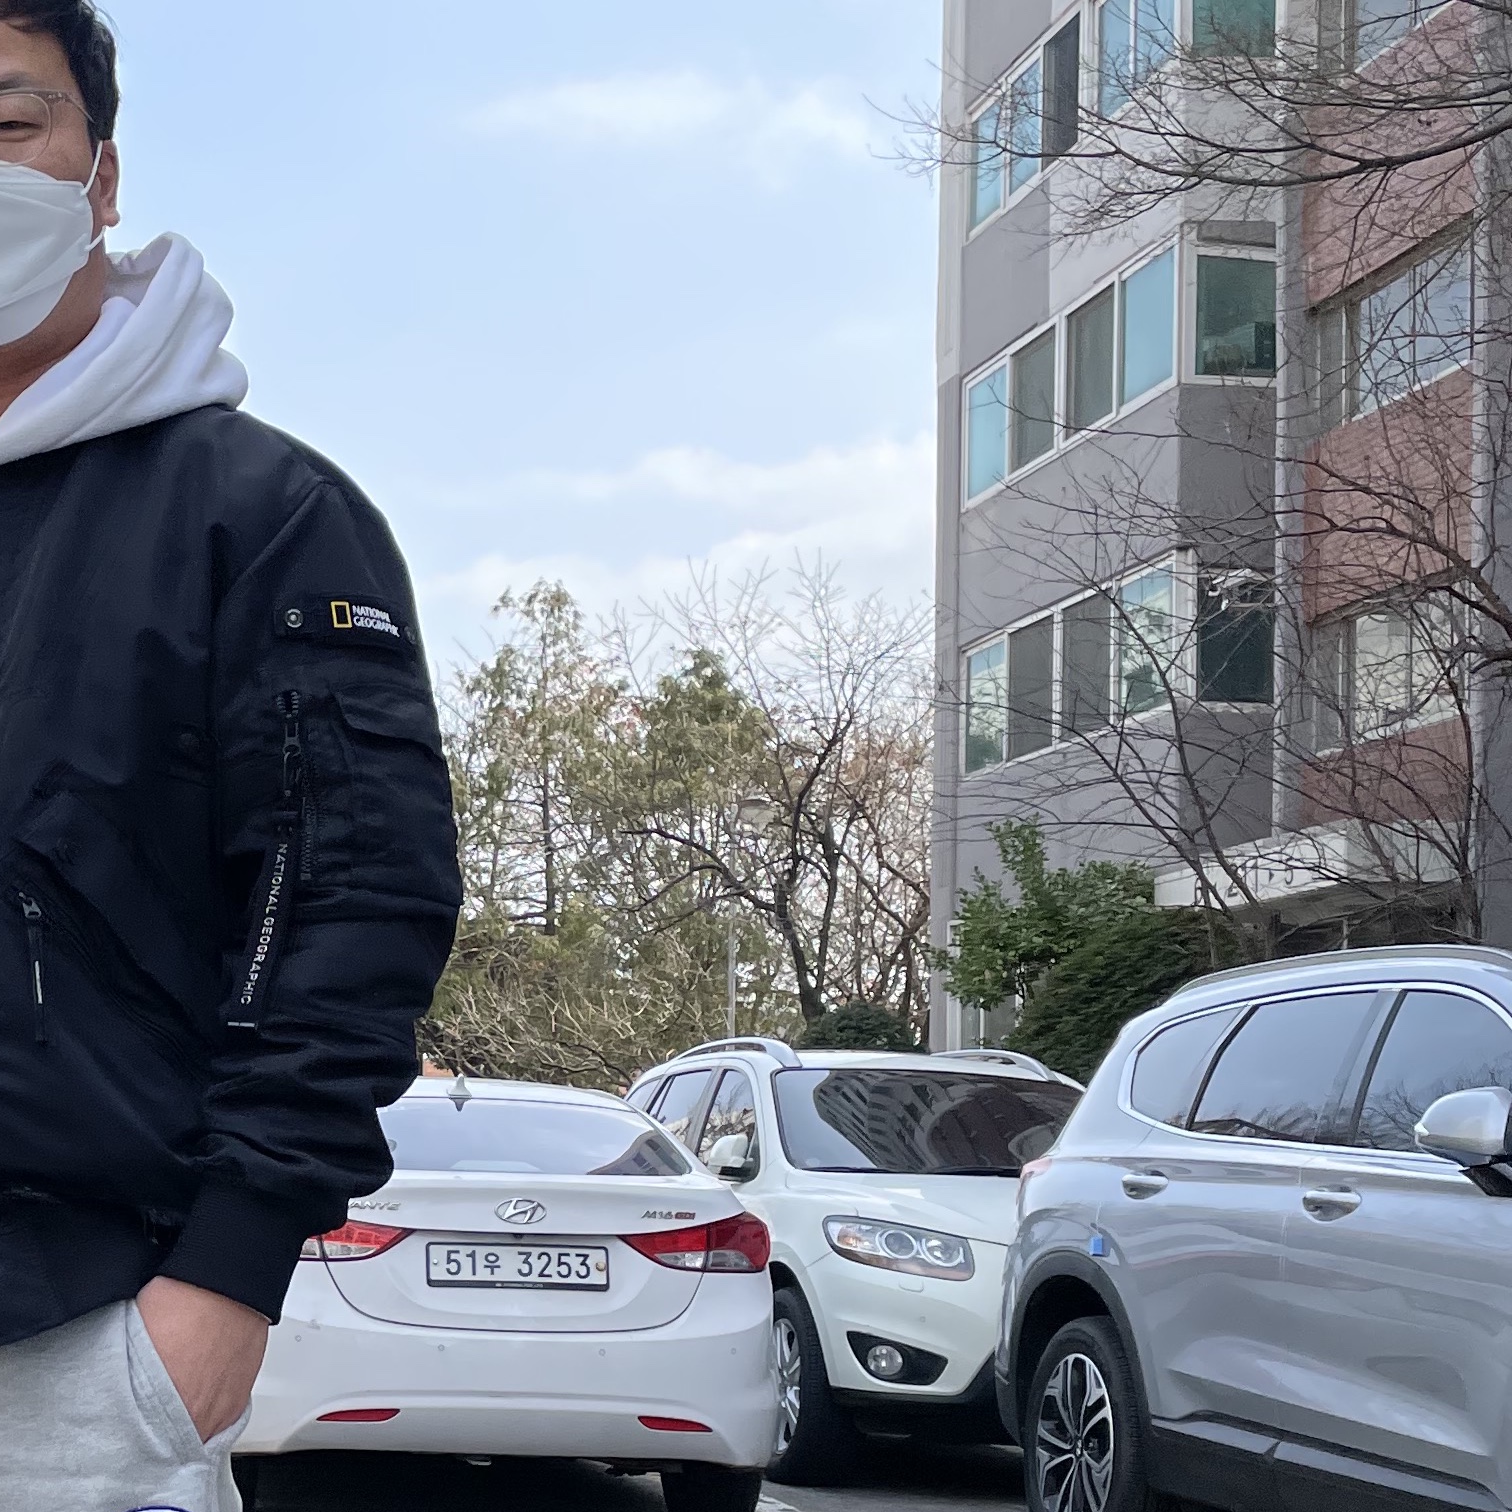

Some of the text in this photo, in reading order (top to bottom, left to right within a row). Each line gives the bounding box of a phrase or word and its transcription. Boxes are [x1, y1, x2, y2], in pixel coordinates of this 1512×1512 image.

[240, 843, 289, 1005] NATIONAL GEOGRAPHIC
[444, 1250, 591, 1280] 51우 3253
